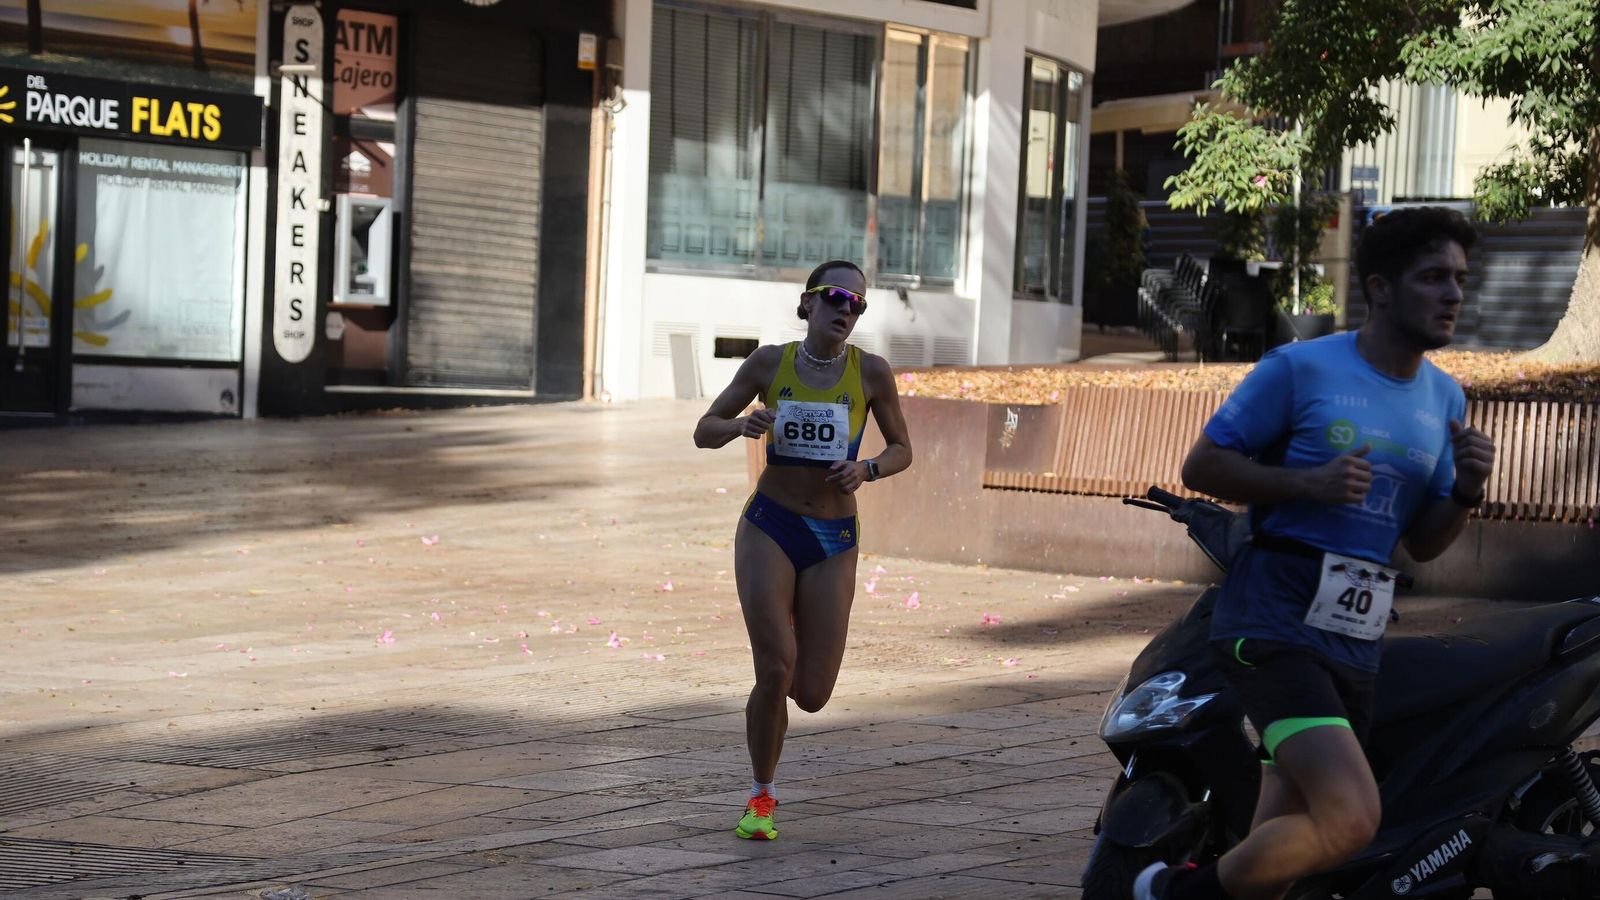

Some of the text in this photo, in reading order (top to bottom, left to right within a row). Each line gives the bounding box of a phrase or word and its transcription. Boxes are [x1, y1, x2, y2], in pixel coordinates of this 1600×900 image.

[336, 20, 393, 56] ATM
[27, 75, 47, 90] DEL
[26, 91, 222, 141] PARQUE FLATS
[79, 152, 128, 168] HOLIDAY
[131, 157, 170, 172] RENTAL
[290, 38, 309, 322] SNEAKERS
[784, 422, 835, 442] 680
[1337, 587, 1373, 615] 40
[1410, 828, 1473, 883] YAMAHA
